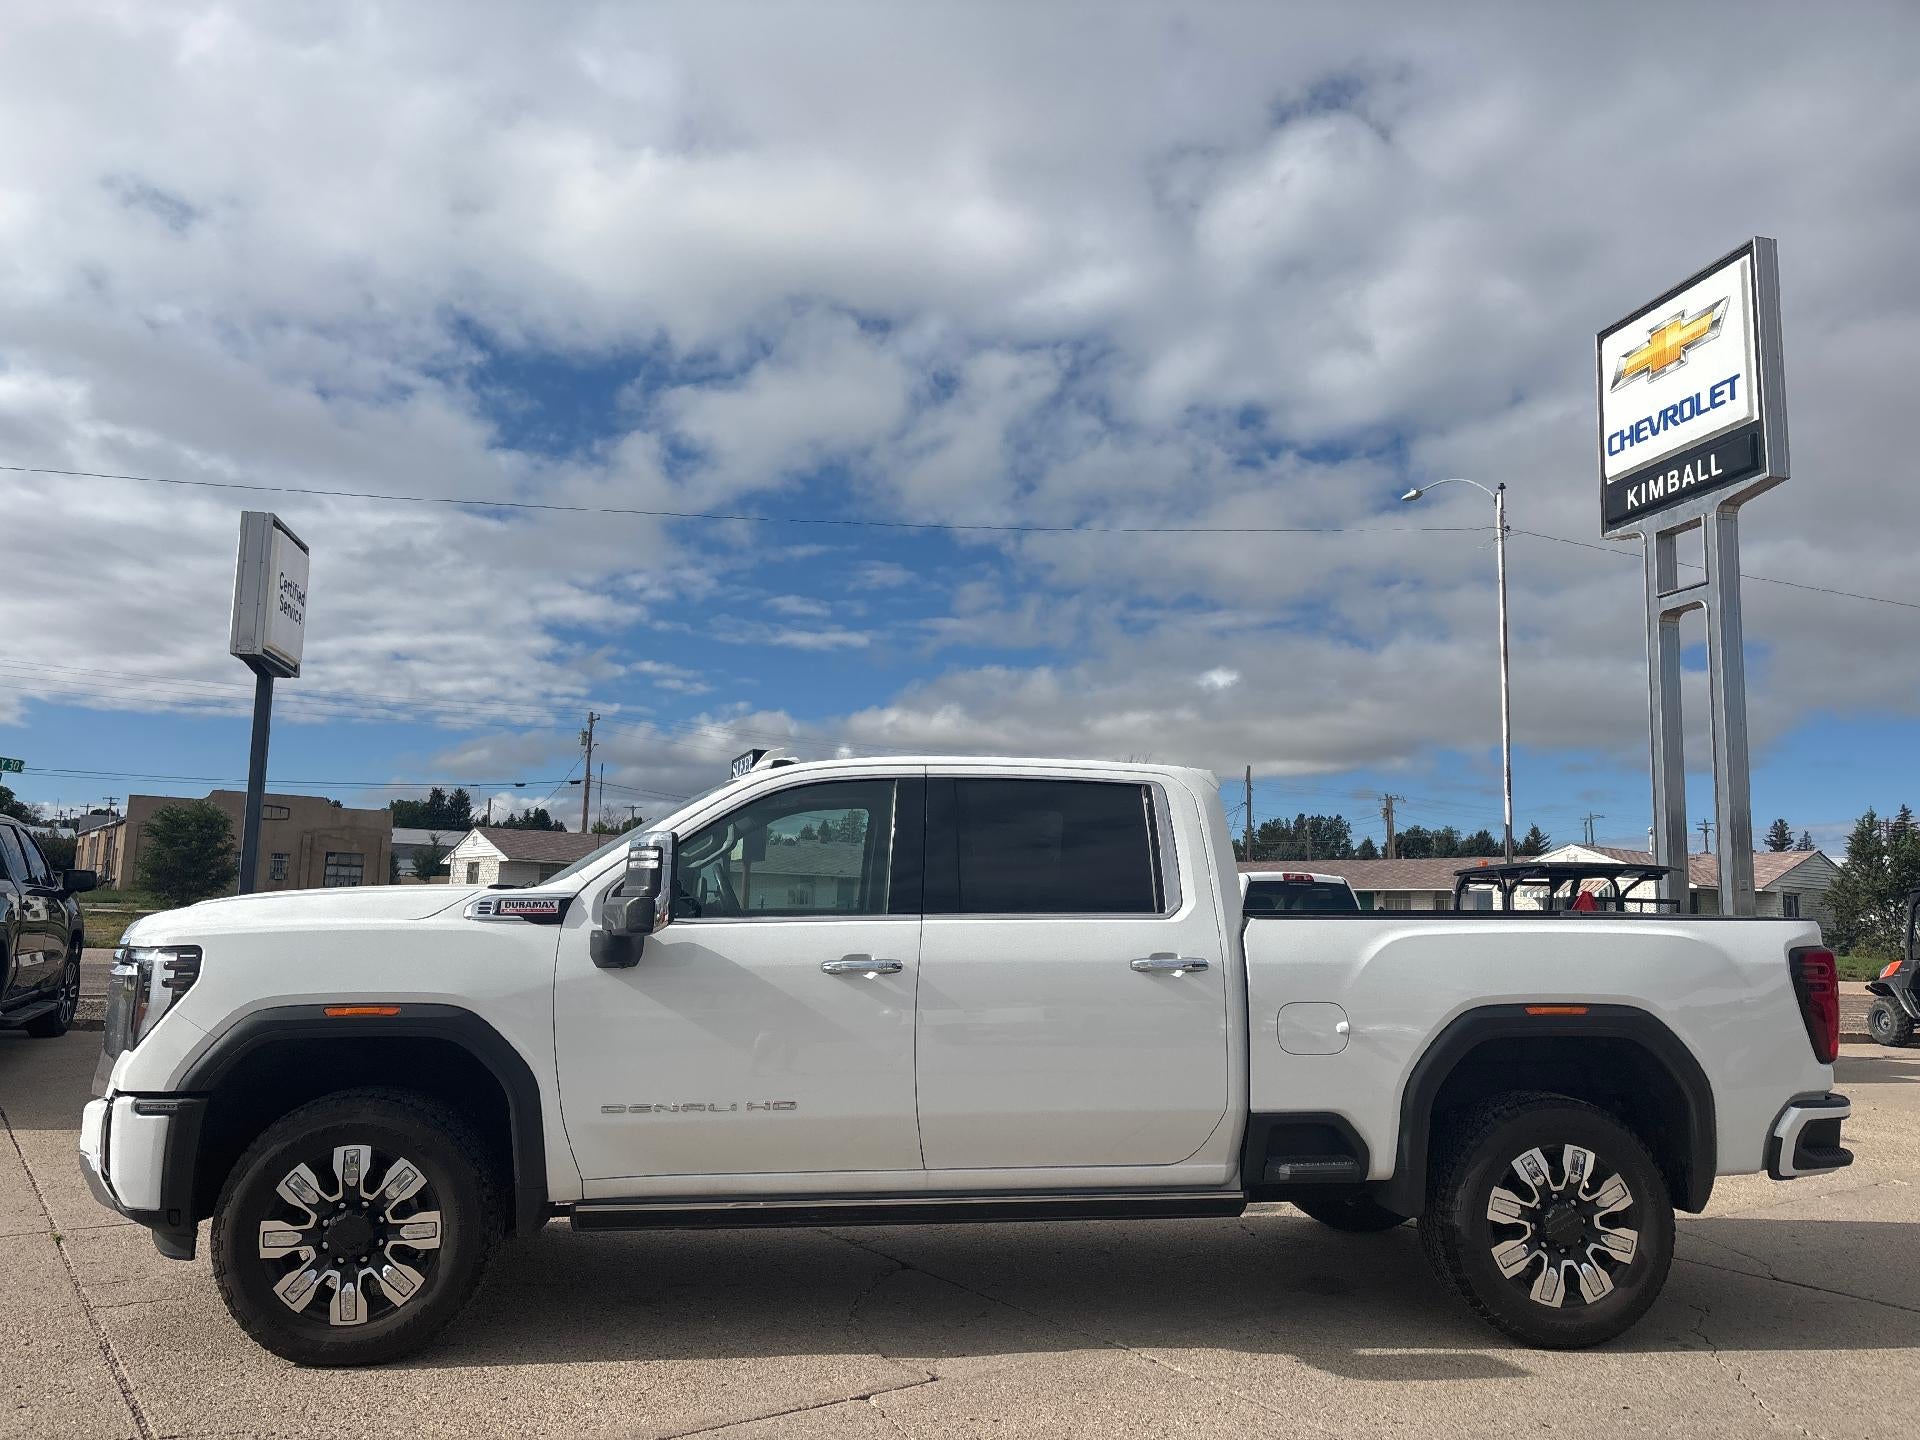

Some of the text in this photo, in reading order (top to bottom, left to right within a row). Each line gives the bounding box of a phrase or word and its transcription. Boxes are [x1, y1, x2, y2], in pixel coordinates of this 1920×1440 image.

[1608, 373, 1740, 457] CHEVROLET
[1626, 454, 1723, 511] KIMBALL
[279, 572, 306, 608] Certified
[279, 594, 302, 625] Service
[8, 760, 20, 770] 30
[504, 901, 555, 909] DURAMAX
[601, 1101, 798, 1114] DENALI HD
